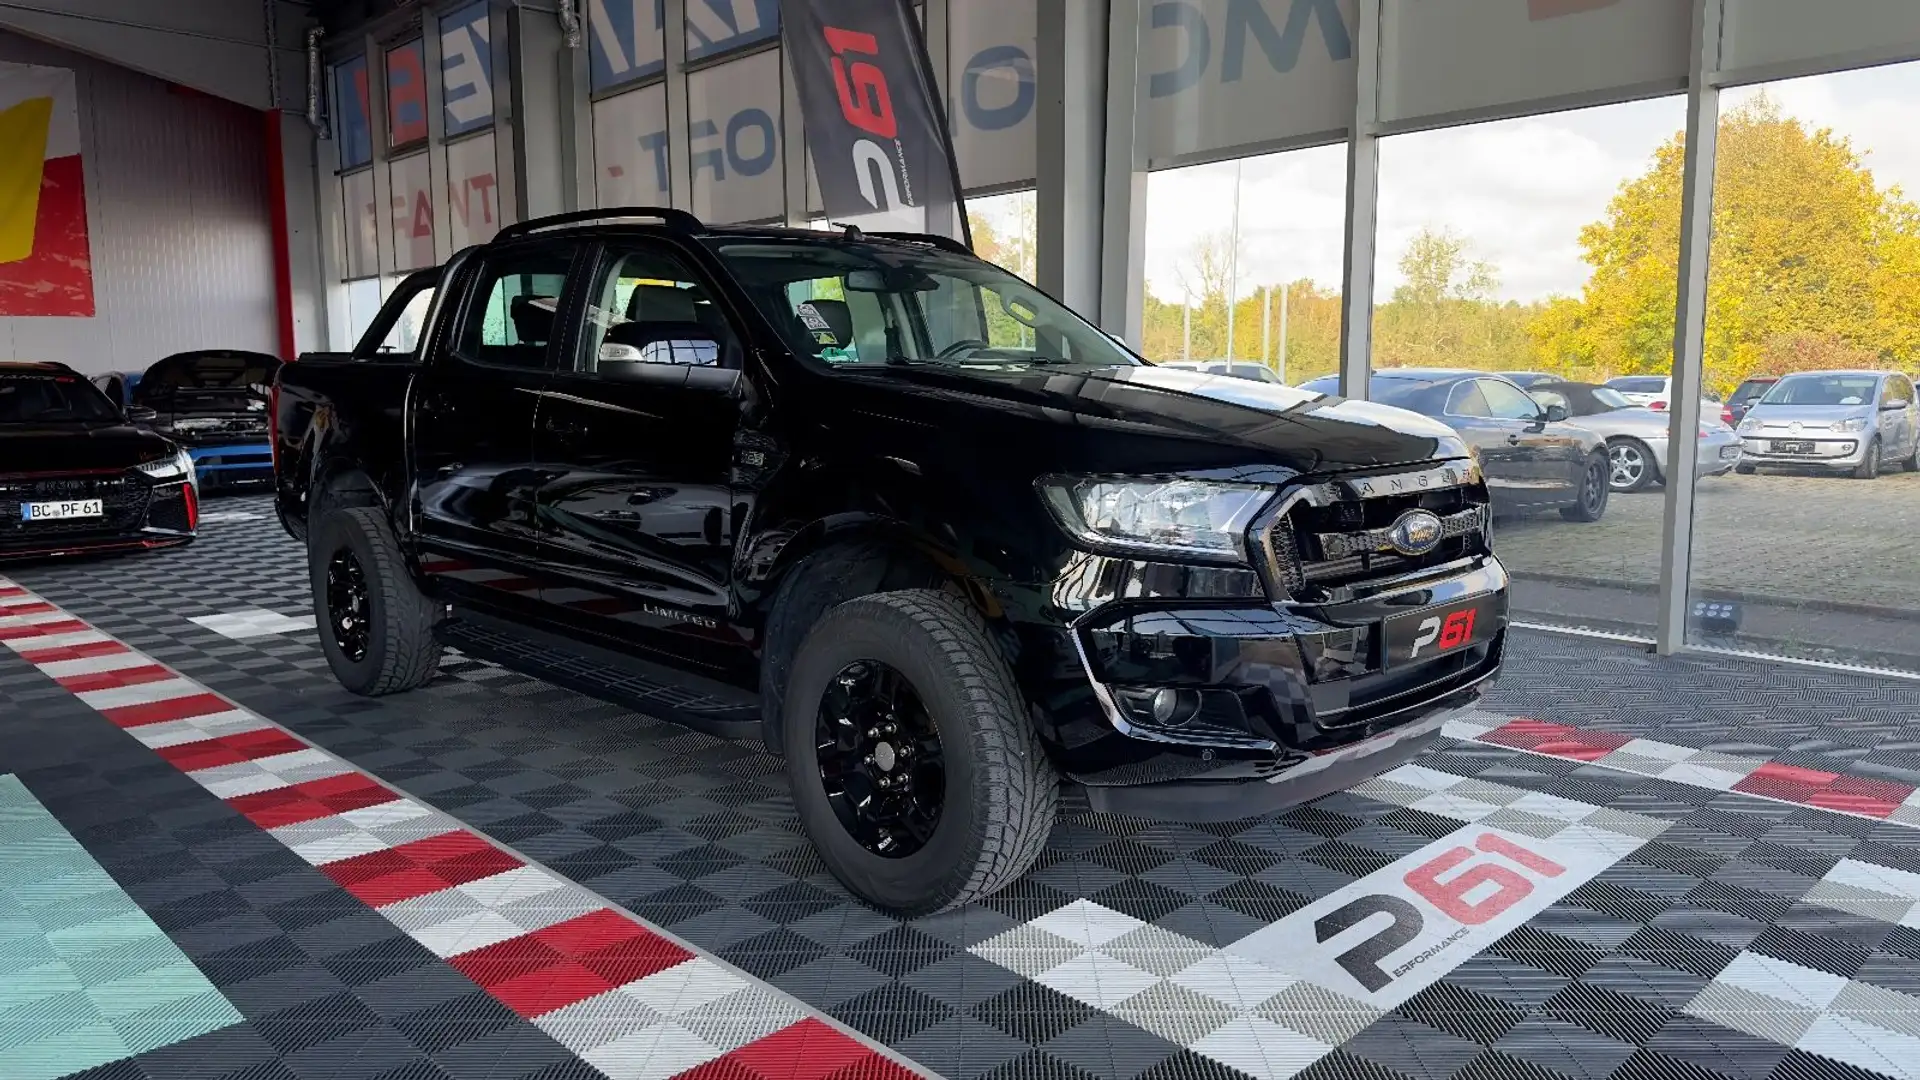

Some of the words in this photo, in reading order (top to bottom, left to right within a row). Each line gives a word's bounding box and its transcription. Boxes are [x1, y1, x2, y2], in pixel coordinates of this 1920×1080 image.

[823, 26, 902, 212] P61
[31, 505, 51, 517] BC
[61, 502, 79, 516] PF
[83, 501, 101, 514] 61
[1411, 608, 1477, 658] P61
[1314, 833, 1567, 993] P61
